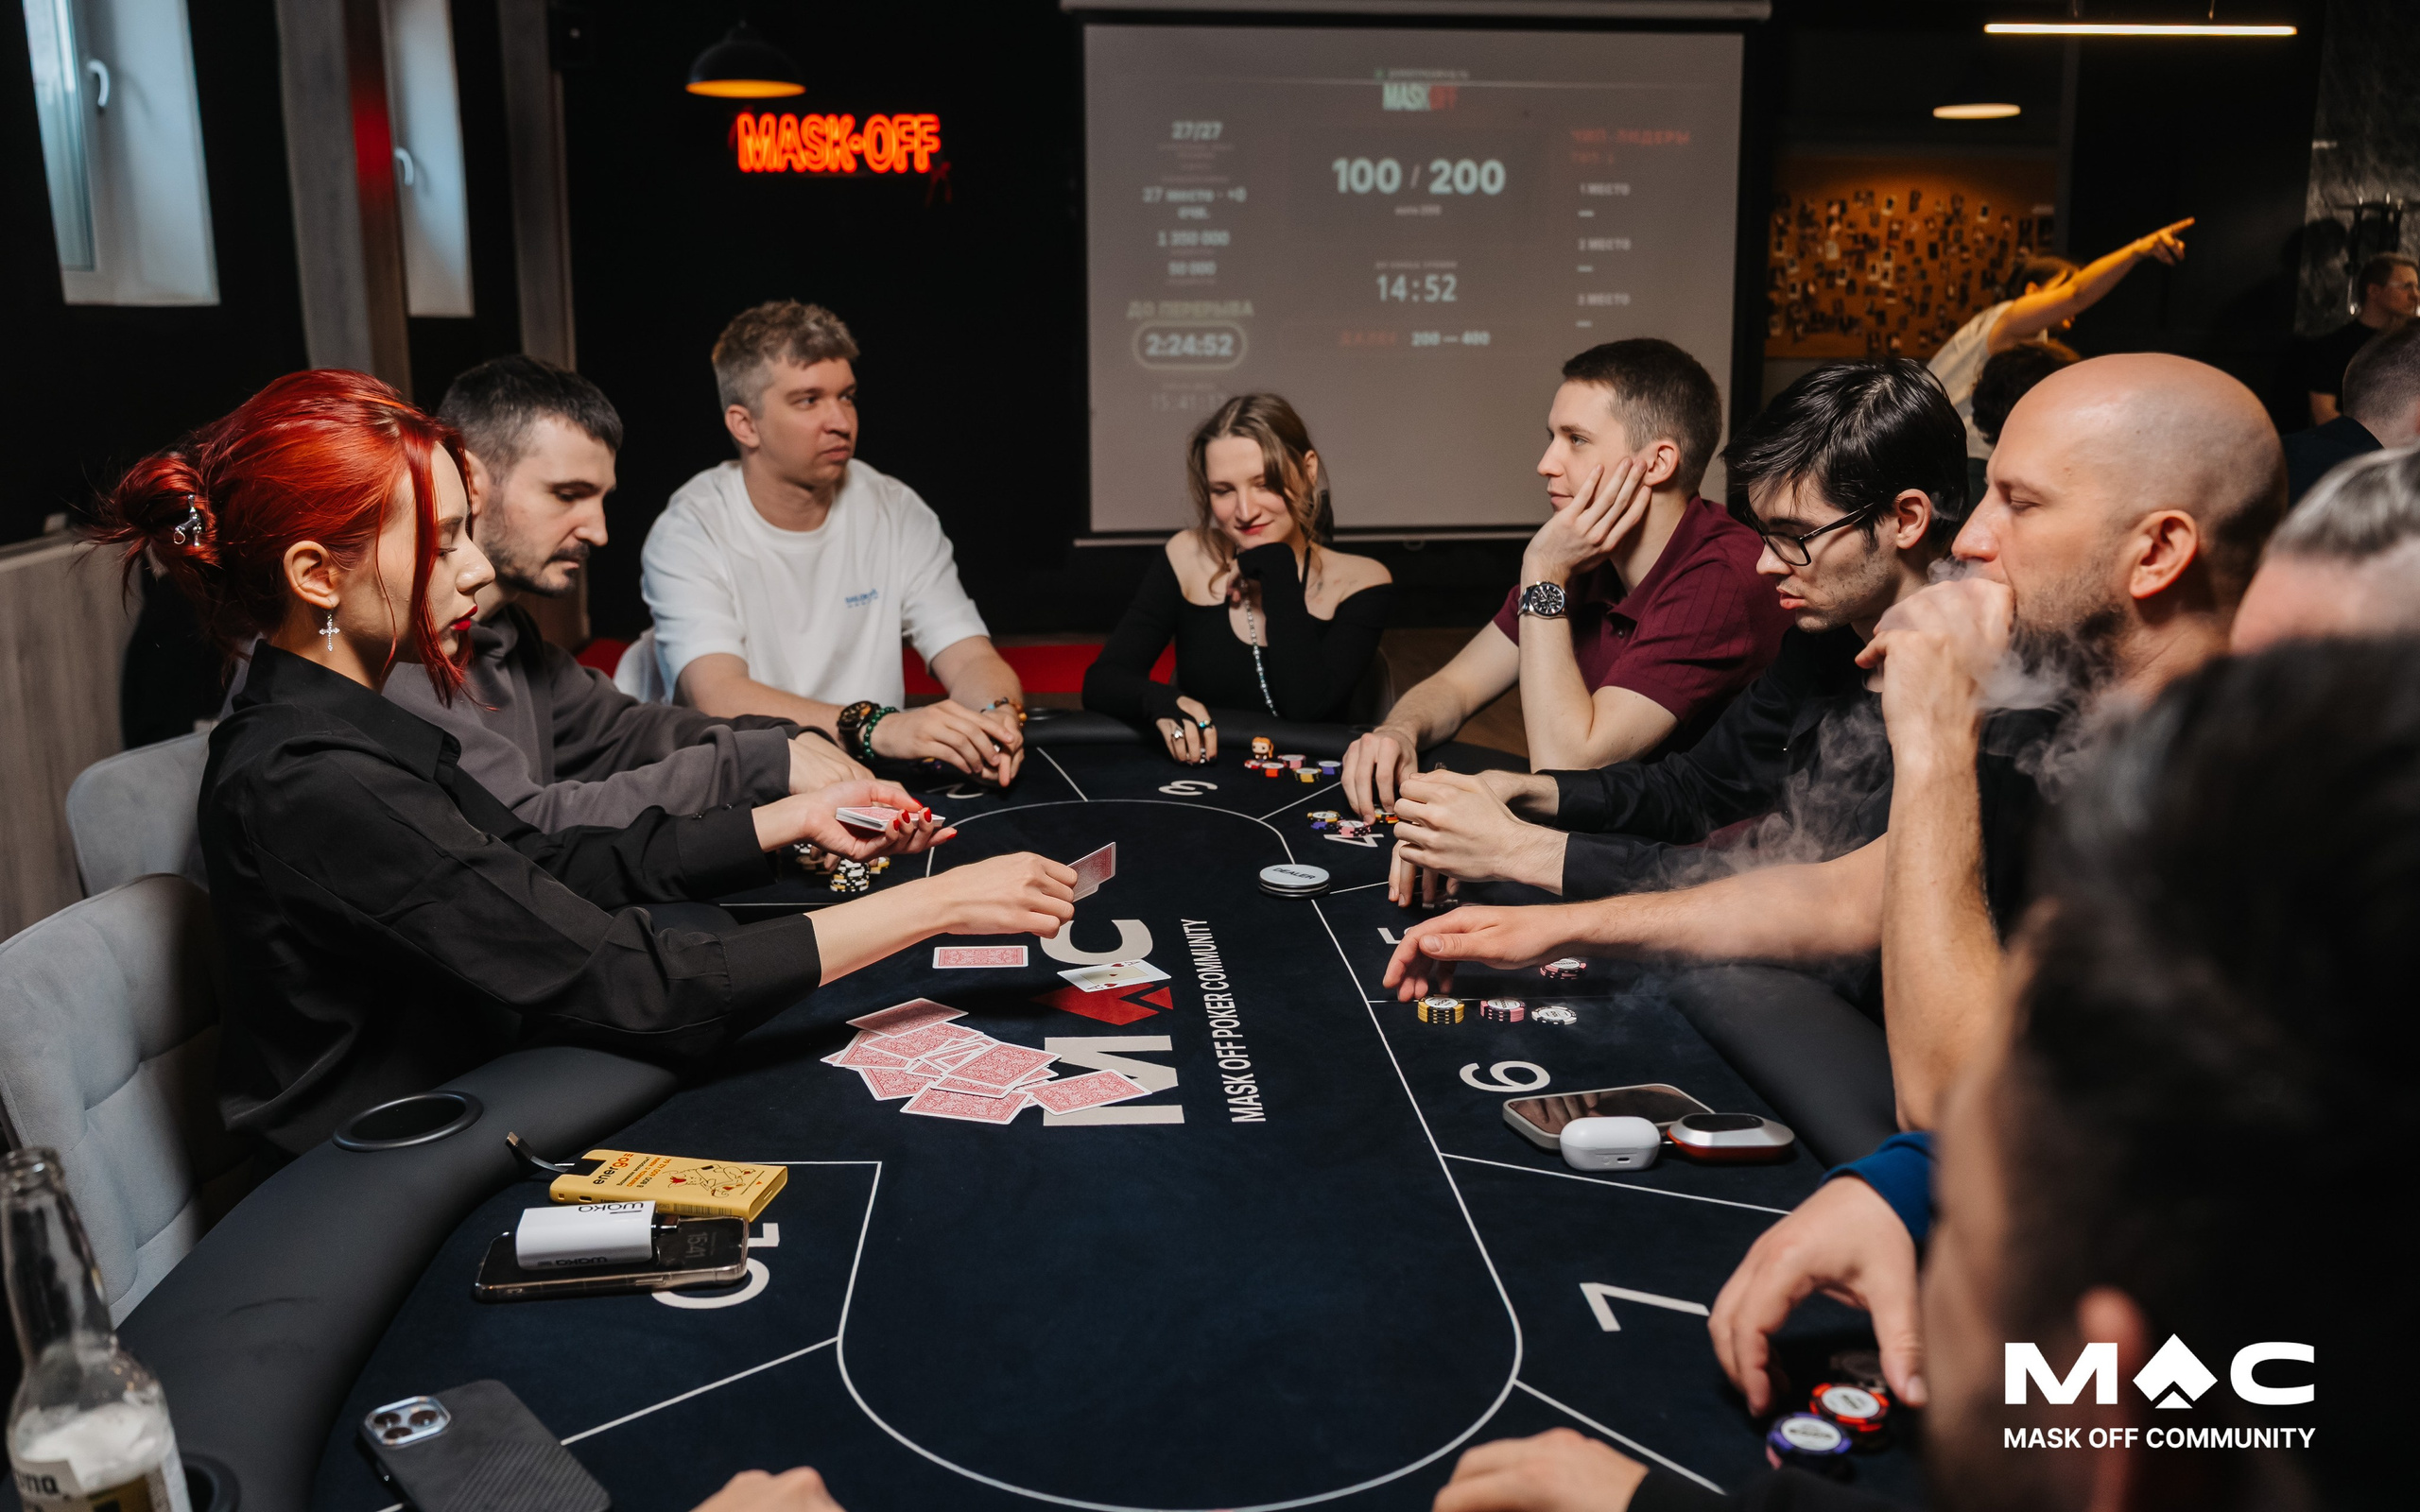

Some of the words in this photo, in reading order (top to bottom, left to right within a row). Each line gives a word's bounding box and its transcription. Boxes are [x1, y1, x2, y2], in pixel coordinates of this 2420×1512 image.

[1333, 158, 1401, 195] 100
[1427, 159, 1506, 196] 200
[1376, 273, 1458, 303] 14:52
[1145, 334, 1235, 357] 2:24:52
[1158, 780, 1218, 796] 3
[1272, 867, 1316, 881] DEALER
[1181, 919, 1230, 991] COMMUNITY
[1203, 992, 1244, 1039] POKER
[1214, 1040, 1252, 1071] OFF
[1459, 1060, 1551, 1091] 6
[1221, 1073, 1267, 1123] MASK
[578, 1201, 645, 1213] waka
[556, 1256, 608, 1267] waka
